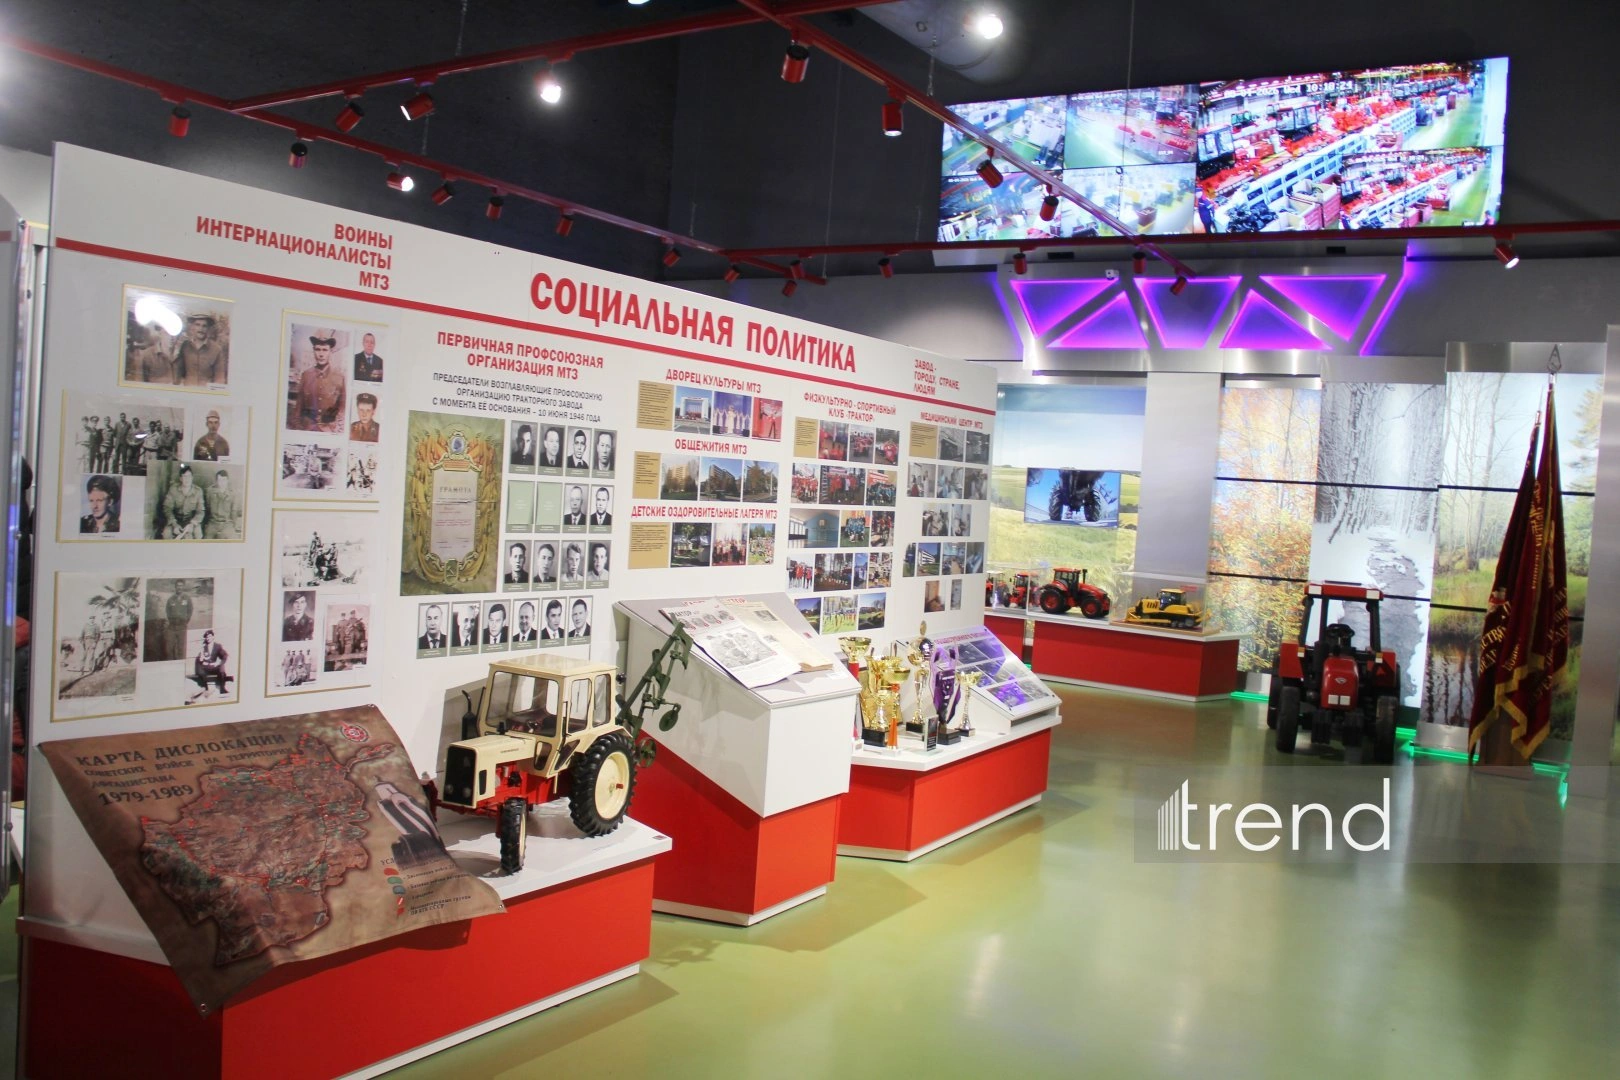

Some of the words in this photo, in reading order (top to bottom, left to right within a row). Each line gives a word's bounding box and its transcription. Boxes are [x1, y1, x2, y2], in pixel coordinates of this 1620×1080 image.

[196, 216, 391, 270] ИНТЕРНАЦИОНАЛИСТЫ
[335, 224, 393, 250] ВОИНЫ
[359, 271, 390, 291] МТЗ
[530, 272, 734, 347] СОЦИАЛЬНАЯ
[746, 321, 856, 373] ПОЛИТИКА
[437, 331, 513, 355] ПЕРВИЧНАЯ
[516, 344, 604, 368] ПРОФСОЮЗНАЯ
[467, 353, 554, 377] ОРГАНИЗАЦИЯ
[556, 367, 579, 380] МТЗ
[915, 359, 934, 372] ЗАВОД
[433, 372, 490, 388] ПРЕДСЕДАТЕЛИ
[491, 380, 552, 395] ВОЗГЛАВЛЯЮЩИЕ
[553, 388, 603, 401] ПРОФСОЮЗНУЮ
[666, 369, 702, 384] ДВОРЕЦ
[703, 375, 744, 391] КУЛЬТУРЫ
[746, 382, 761, 394] МТЗ
[914, 383, 936, 395] ЛЮДЯМ
[432, 397, 438, 406] С
[439, 398, 476, 410] МОМЕНТА
[488, 403, 531, 415] ОСНОВАНИЯ
[538, 409, 547, 417] 10
[547, 410, 568, 419] ИЮНЯ
[569, 412, 585, 421] 1946
[585, 414, 601, 423] ГОДА
[456, 388, 511, 401] ОРГАНИЗАЦИЮ
[512, 394, 557, 407] ТРАКТОРНОГО
[558, 401, 583, 410] ЗАВОДА
[828, 408, 845, 418] КЛУБ
[920, 412, 957, 425] МЕДИЦИНСКИЙ
[959, 418, 973, 427] ЦЕНТР
[674, 438, 730, 453] ОБЩЕЖИТИЯ
[732, 444, 748, 455] МТЗ
[631, 505, 666, 518] ДЕТСКИЕ
[667, 506, 739, 519] ОЗДОРОВИТЕЛЬНЫЕ
[739, 508, 764, 519] ЛАГЕРЯ
[765, 509, 777, 520] МТЗ
[75, 750, 148, 767] КАРТА
[155, 733, 287, 760] ДИСЛОКАЦИИ
[84, 766, 147, 777] СОВЕТСКИХ
[155, 759, 195, 771] ВОЙСК
[203, 756, 219, 765] НА
[226, 747, 293, 762] ТЕРРИТОРИИ
[91, 773, 176, 788] АФГАНИСТАНА
[98, 784, 194, 806] 1979-1989
